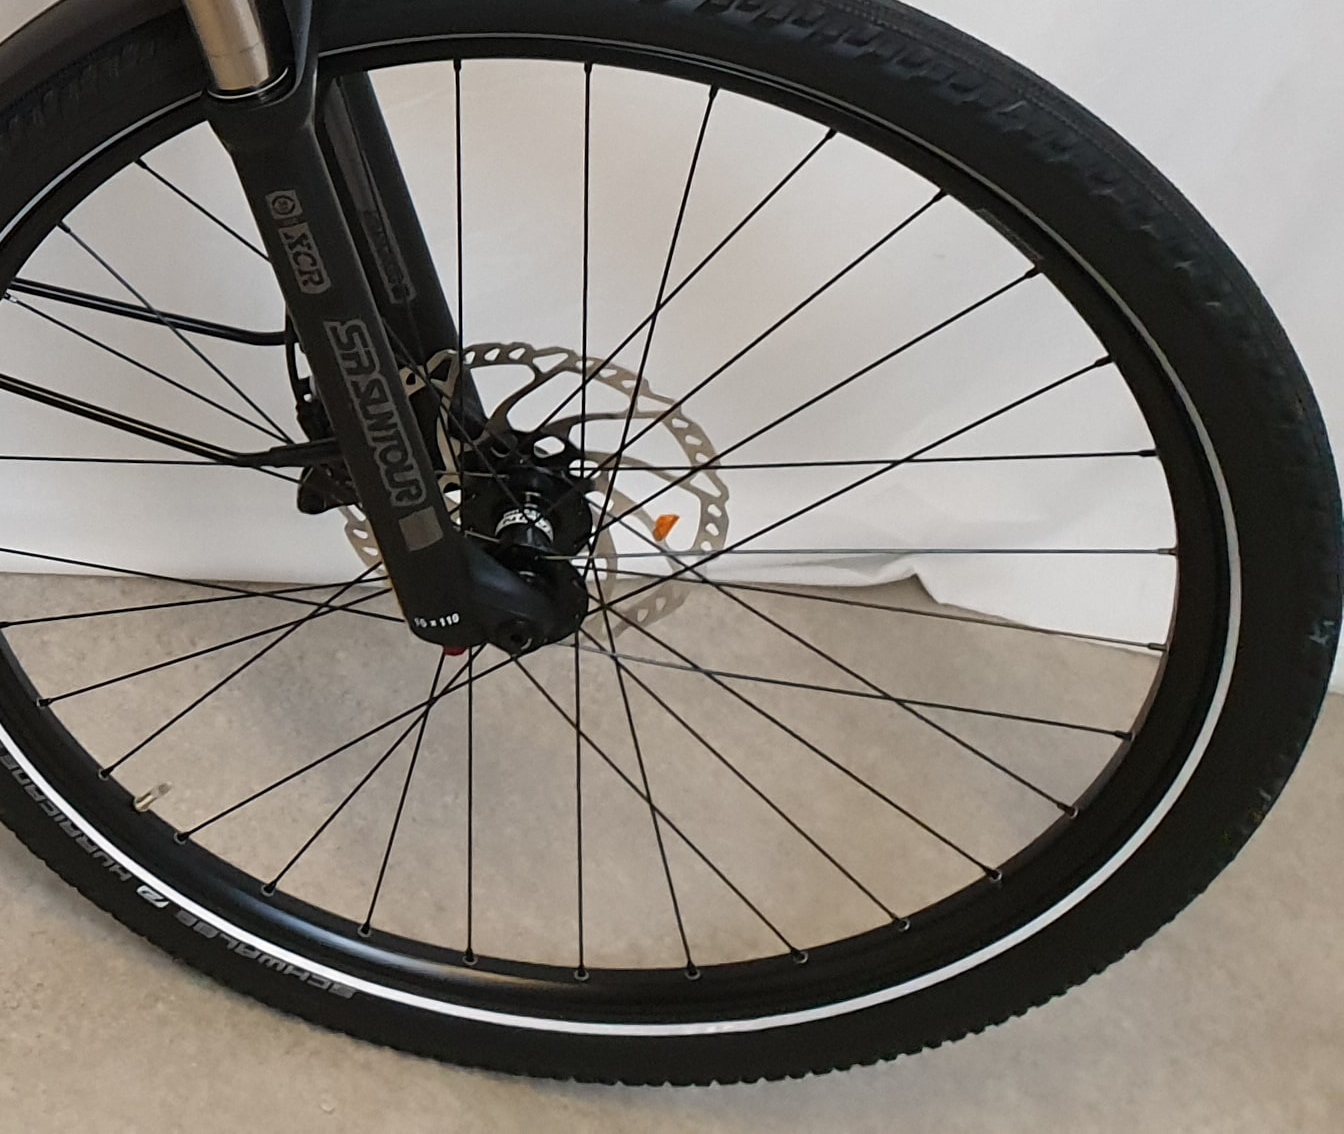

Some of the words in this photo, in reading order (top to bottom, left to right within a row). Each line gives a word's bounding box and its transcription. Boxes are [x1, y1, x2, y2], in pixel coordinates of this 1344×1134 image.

[281, 230, 325, 288] XCR
[439, 613, 460, 627] 110
[175, 909, 360, 1000] SCHWALBE
